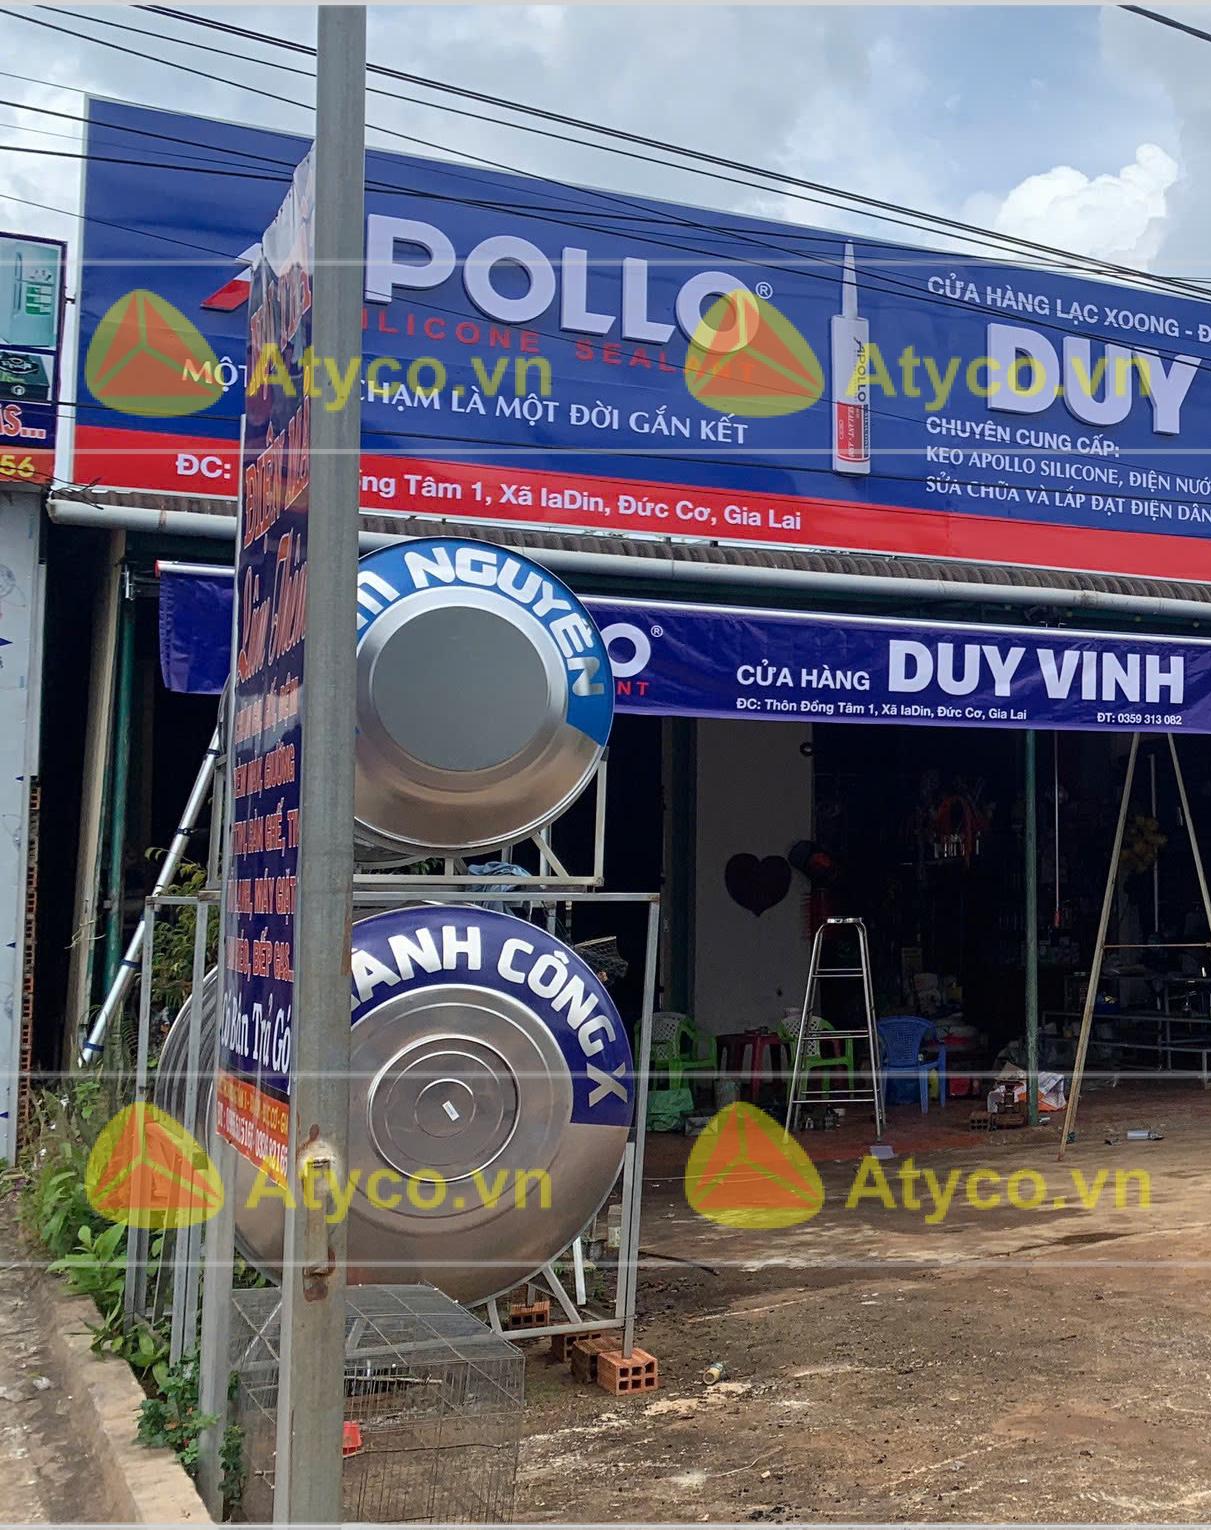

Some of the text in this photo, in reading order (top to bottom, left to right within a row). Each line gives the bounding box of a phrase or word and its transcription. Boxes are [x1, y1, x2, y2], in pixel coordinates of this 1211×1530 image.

[202, 213, 760, 355] POLLO
[927, 271, 981, 304] CỬA
[987, 284, 1050, 315] HÀNG
[1056, 298, 1099, 326] LẠC
[1104, 306, 1180, 339] XOONG
[361, 305, 541, 353] ILICONE
[986, 322, 1202, 436] DUY
[360, 380, 440, 411] HẠM
[451, 386, 486, 415] LÀ
[495, 393, 560, 427] MỘT
[569, 401, 619, 430] ĐỜI
[629, 405, 691, 439] GẮN
[700, 413, 749, 445] KẾT
[926, 415, 1120, 458] CHUYÊN CUNG CẤP:
[175, 453, 232, 480] ĐC:
[403, 473, 462, 499] Tâm
[500, 484, 532, 506] Xã
[618, 494, 669, 518] Đức
[676, 500, 717, 526] Cơ,
[724, 505, 761, 527] Gia
[769, 509, 801, 531] Lai
[926, 446, 964, 465] KEO
[969, 453, 1036, 474] APOLLO
[1041, 462, 1123, 488] SILICONE,
[1129, 470, 1171, 493] ĐIỆN
[926, 471, 962, 495] SỬA
[967, 480, 1020, 502] CHỮA
[1026, 484, 1050, 506] VÀ
[1055, 485, 1086, 509] LẮP
[1131, 500, 1173, 521] ĐIỆN
[736, 639, 1185, 704] CỬA HÀNG DUY VINH
[736, 697, 761, 710] ĐC:
[765, 699, 797, 711] Thôn
[800, 699, 834, 715] Đồng
[837, 701, 865, 714] Tâm
[882, 704, 898, 716] Xã
[937, 705, 962, 718] Đức
[965, 707, 985, 720] Cơ,
[989, 708, 1008, 719] Gia
[1010, 708, 1027, 720] Lai
[1097, 712, 1182, 726] ĐT: 0359 313 082
[351, 925, 482, 1011] ÀNH
[497, 938, 617, 1057] CÔNG
